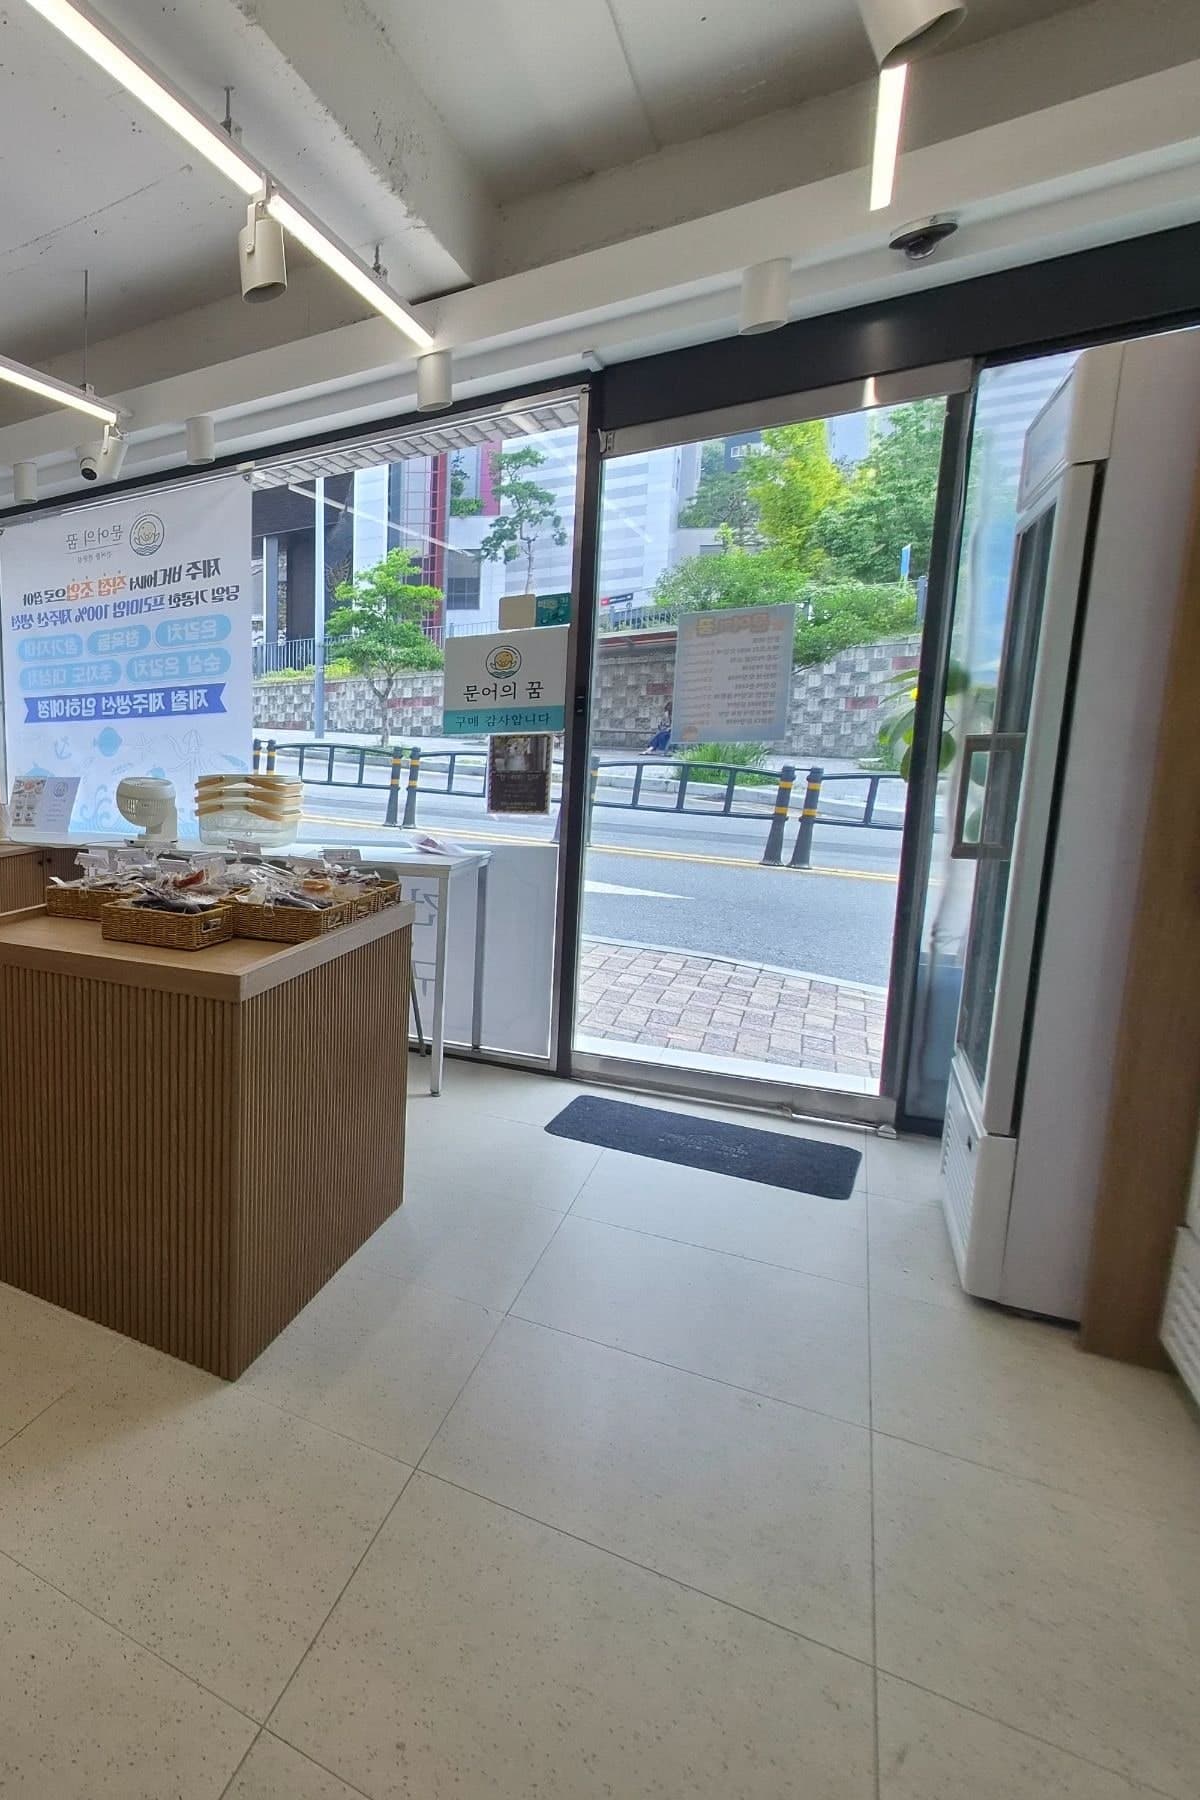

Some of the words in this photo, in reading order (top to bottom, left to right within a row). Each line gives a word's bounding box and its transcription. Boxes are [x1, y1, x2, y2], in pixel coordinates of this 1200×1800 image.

[463, 681, 517, 702] 문어의
[525, 681, 544, 699] 꿈
[455, 715, 479, 729] 구매
